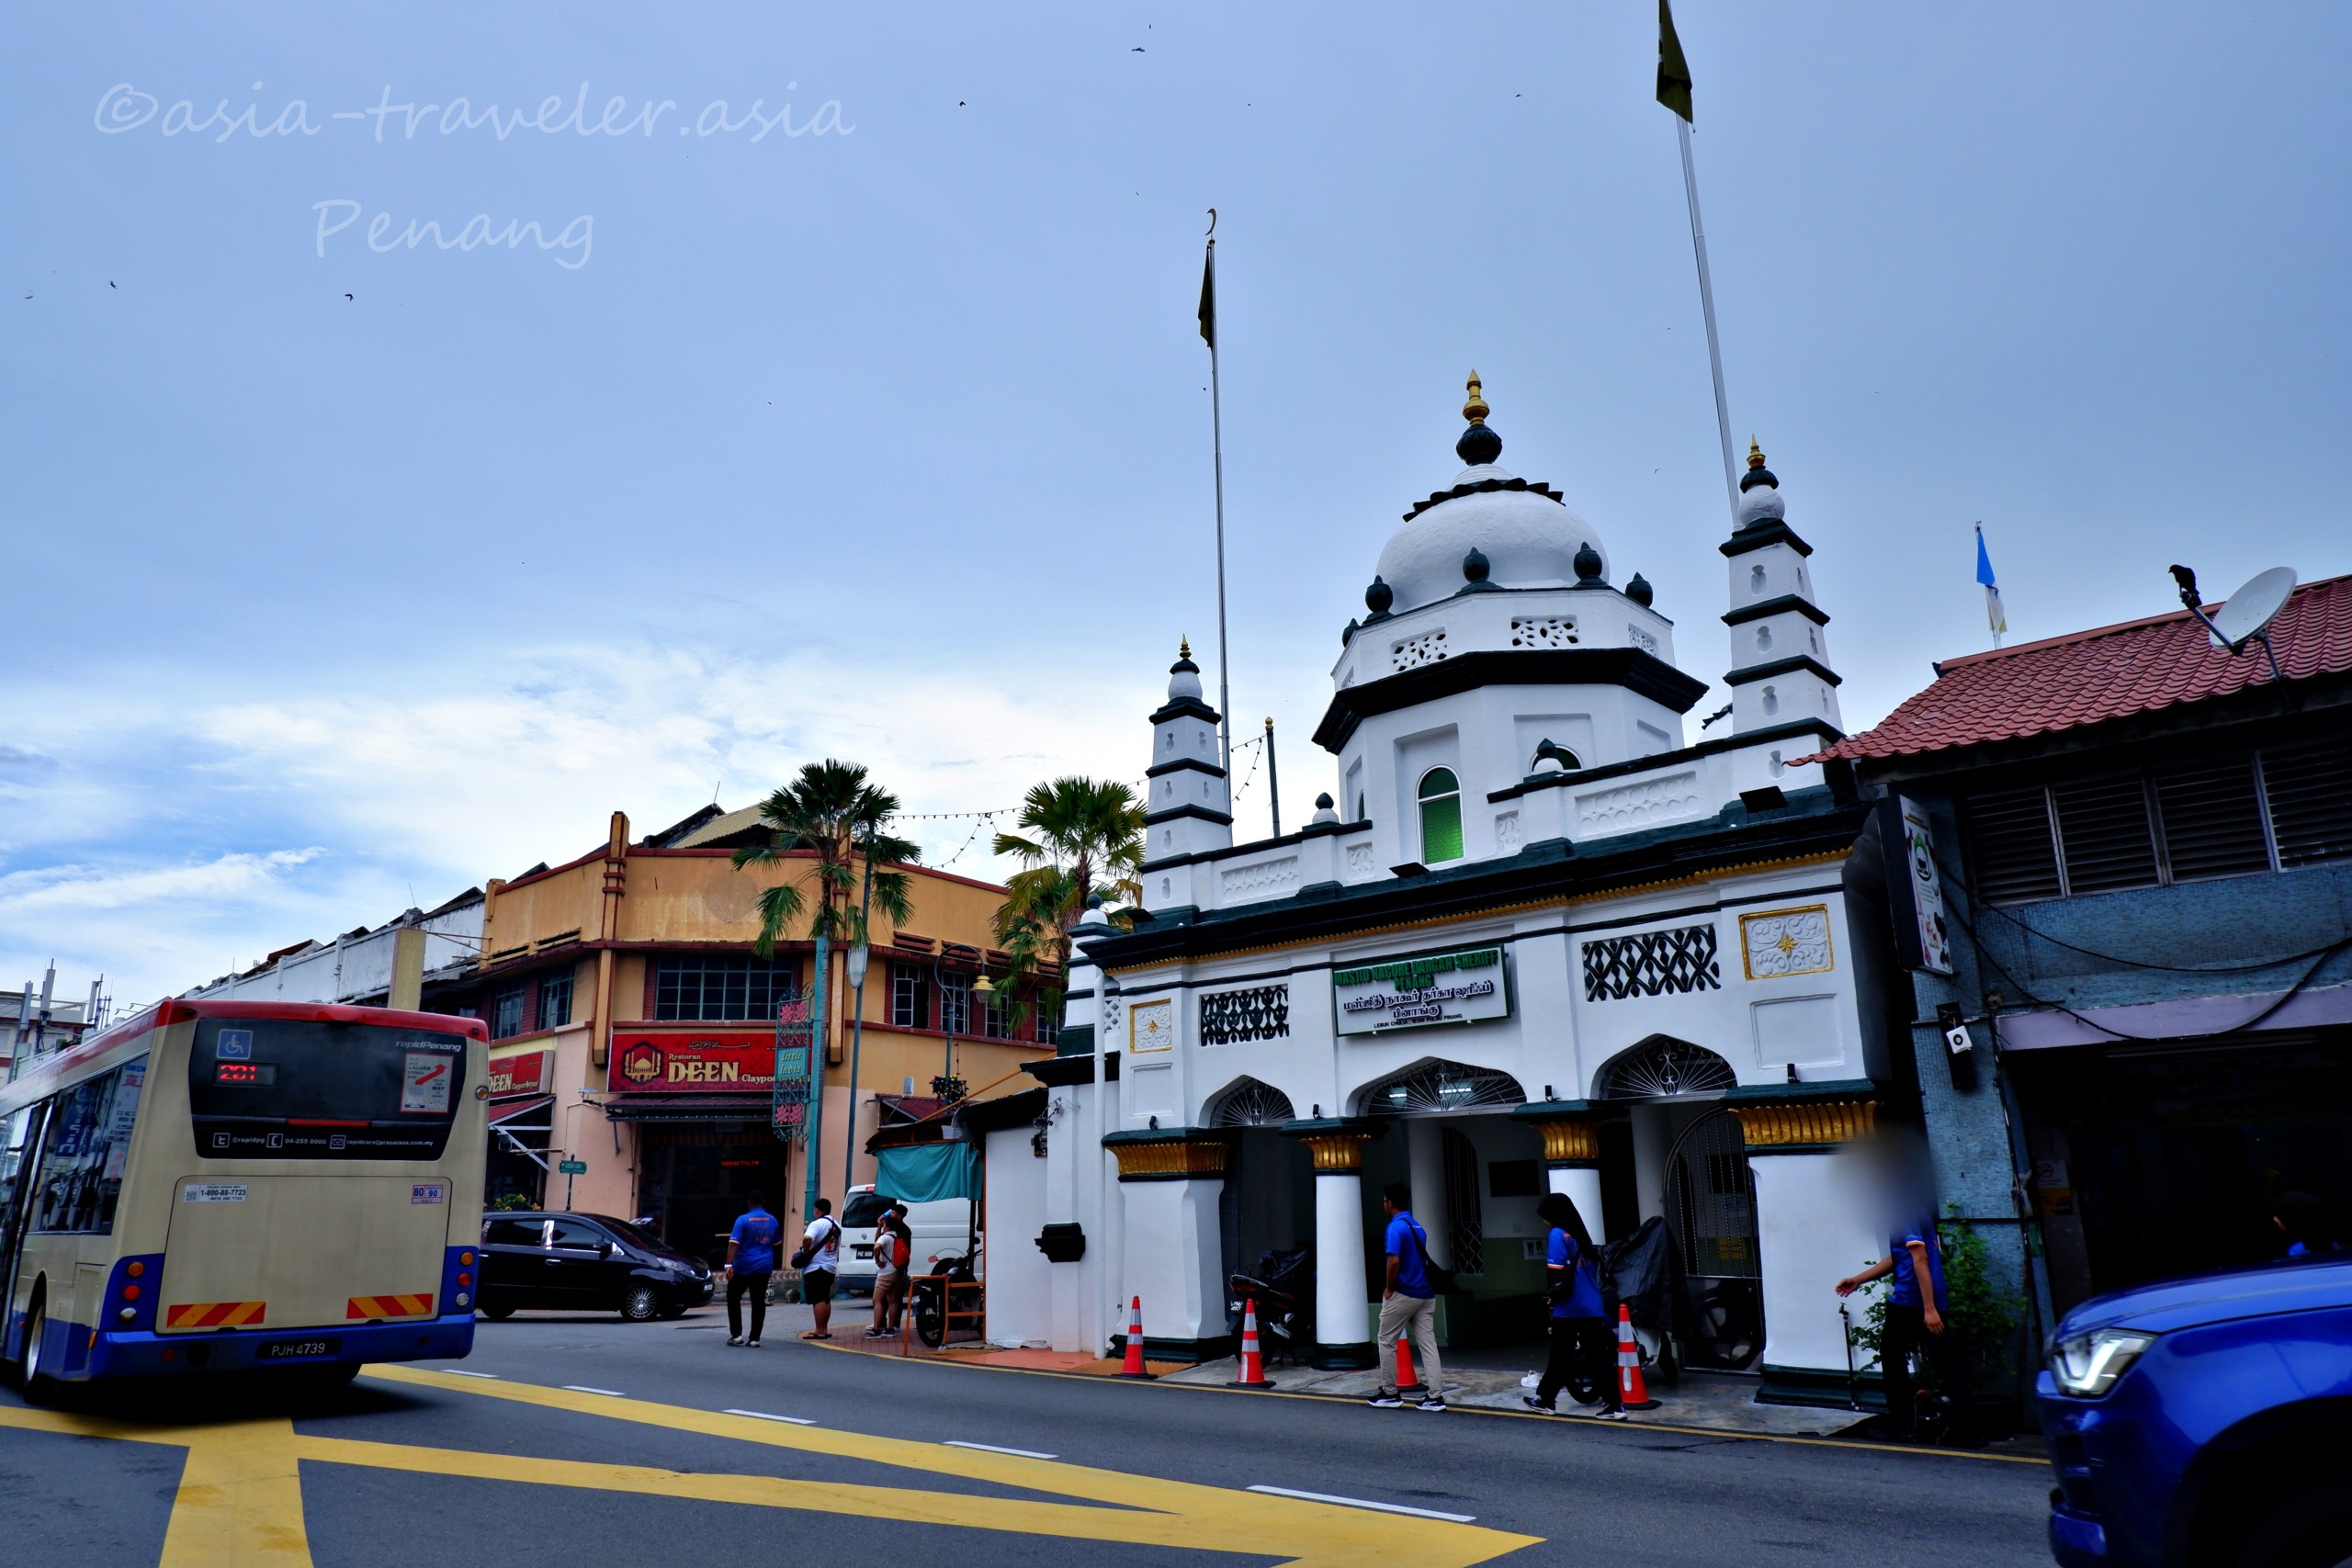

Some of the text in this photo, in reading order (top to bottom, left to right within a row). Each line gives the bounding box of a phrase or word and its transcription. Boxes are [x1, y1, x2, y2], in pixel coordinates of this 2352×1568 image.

[1334, 950, 1498, 986] MASJID NAGORE DARGAH SHERIFF
[1395, 975, 1433, 991] PENANG
[395, 1041, 461, 1052] rapidPenang
[781, 1050, 802, 1062] Little
[220, 1064, 256, 1080] 201
[668, 1062, 740, 1083] DEEN
[780, 1065, 801, 1076] India
[413, 1187, 424, 1197] 80
[271, 1342, 325, 1357] PJH 4739
